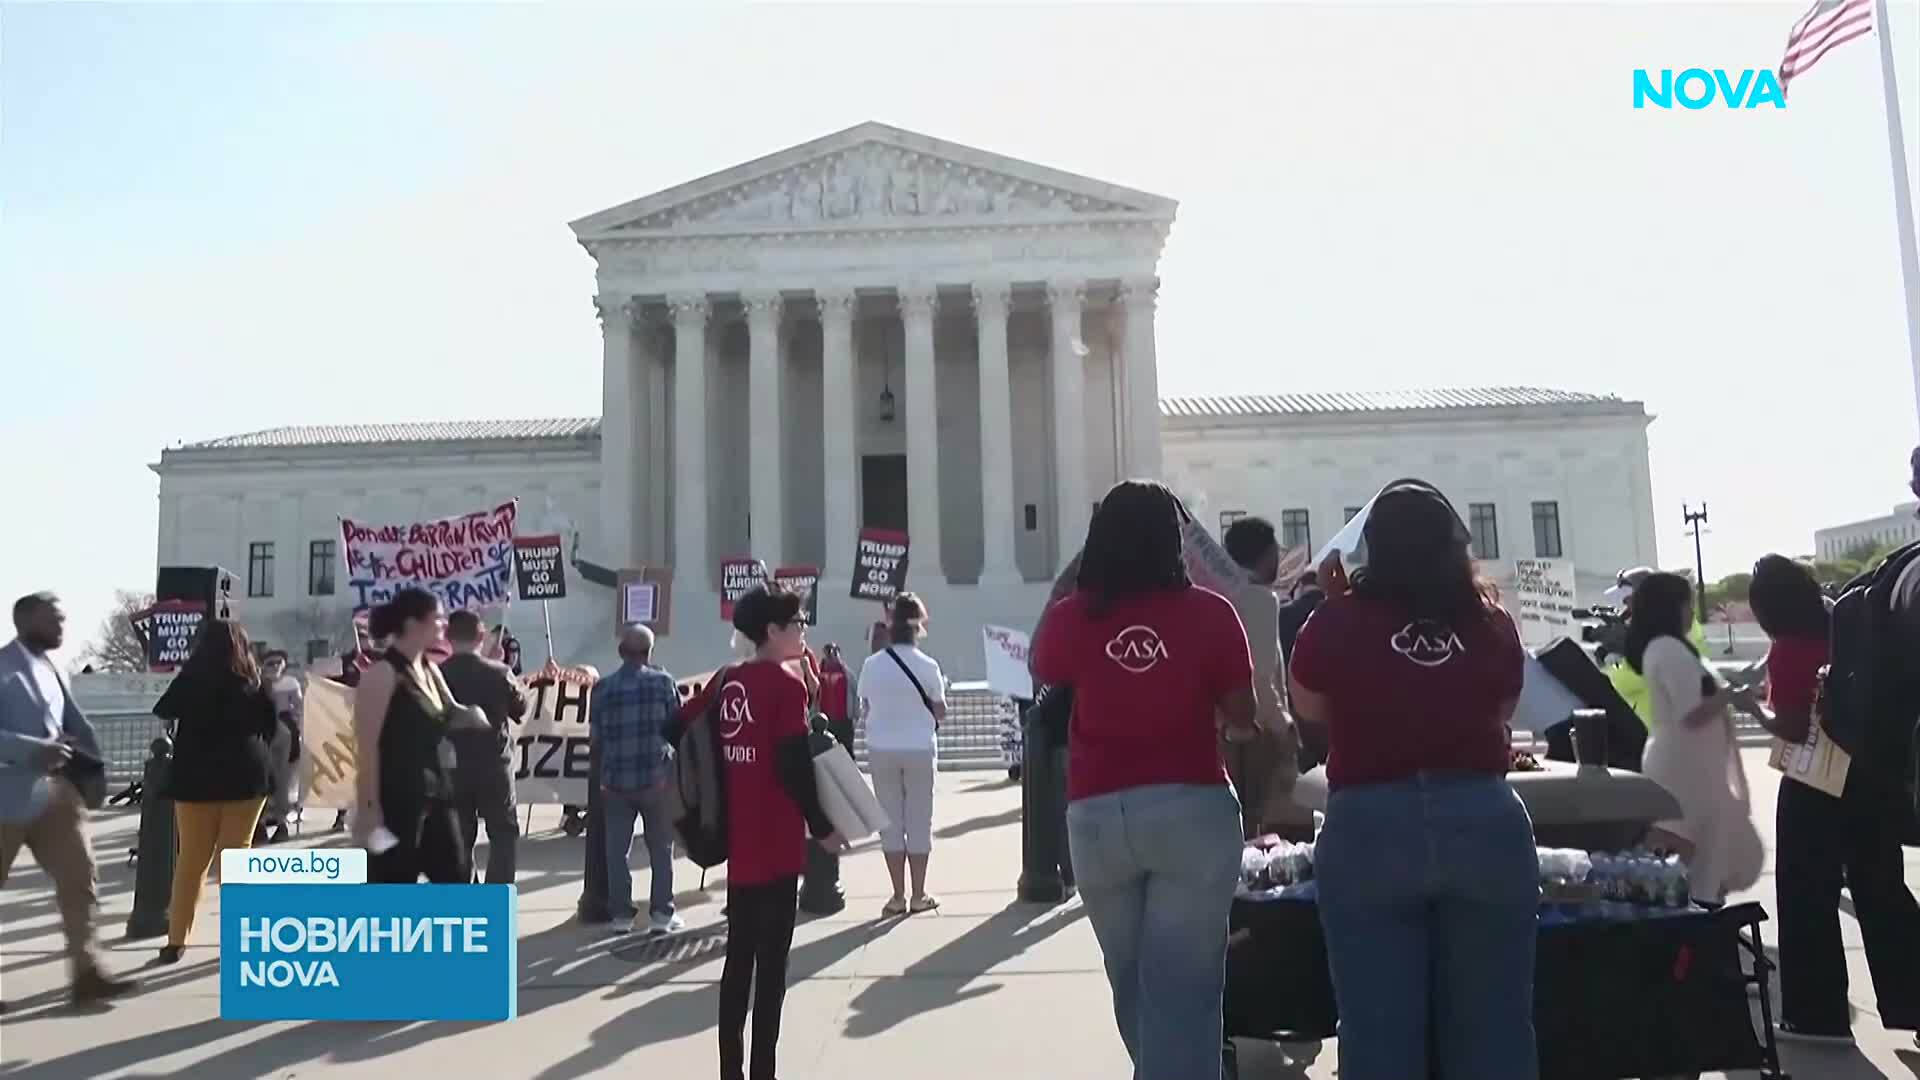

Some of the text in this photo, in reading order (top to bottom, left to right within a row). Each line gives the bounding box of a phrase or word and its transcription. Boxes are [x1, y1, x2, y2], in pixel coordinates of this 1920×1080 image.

[518, 547, 559, 560] TRUMP
[861, 540, 906, 556] TRUMP
[522, 560, 555, 571] MUST
[861, 555, 899, 570] MUST
[532, 571, 550, 584] GO
[868, 569, 889, 583] GO
[527, 583, 559, 597] NOW!
[859, 582, 896, 597] NOW!
[153, 613, 203, 624] TRUMP
[157, 625, 198, 637] MUST
[166, 637, 189, 650] GO
[1105, 638, 1169, 660] CASA
[1391, 631, 1465, 653] CASA
[719, 697, 755, 723] ASA
